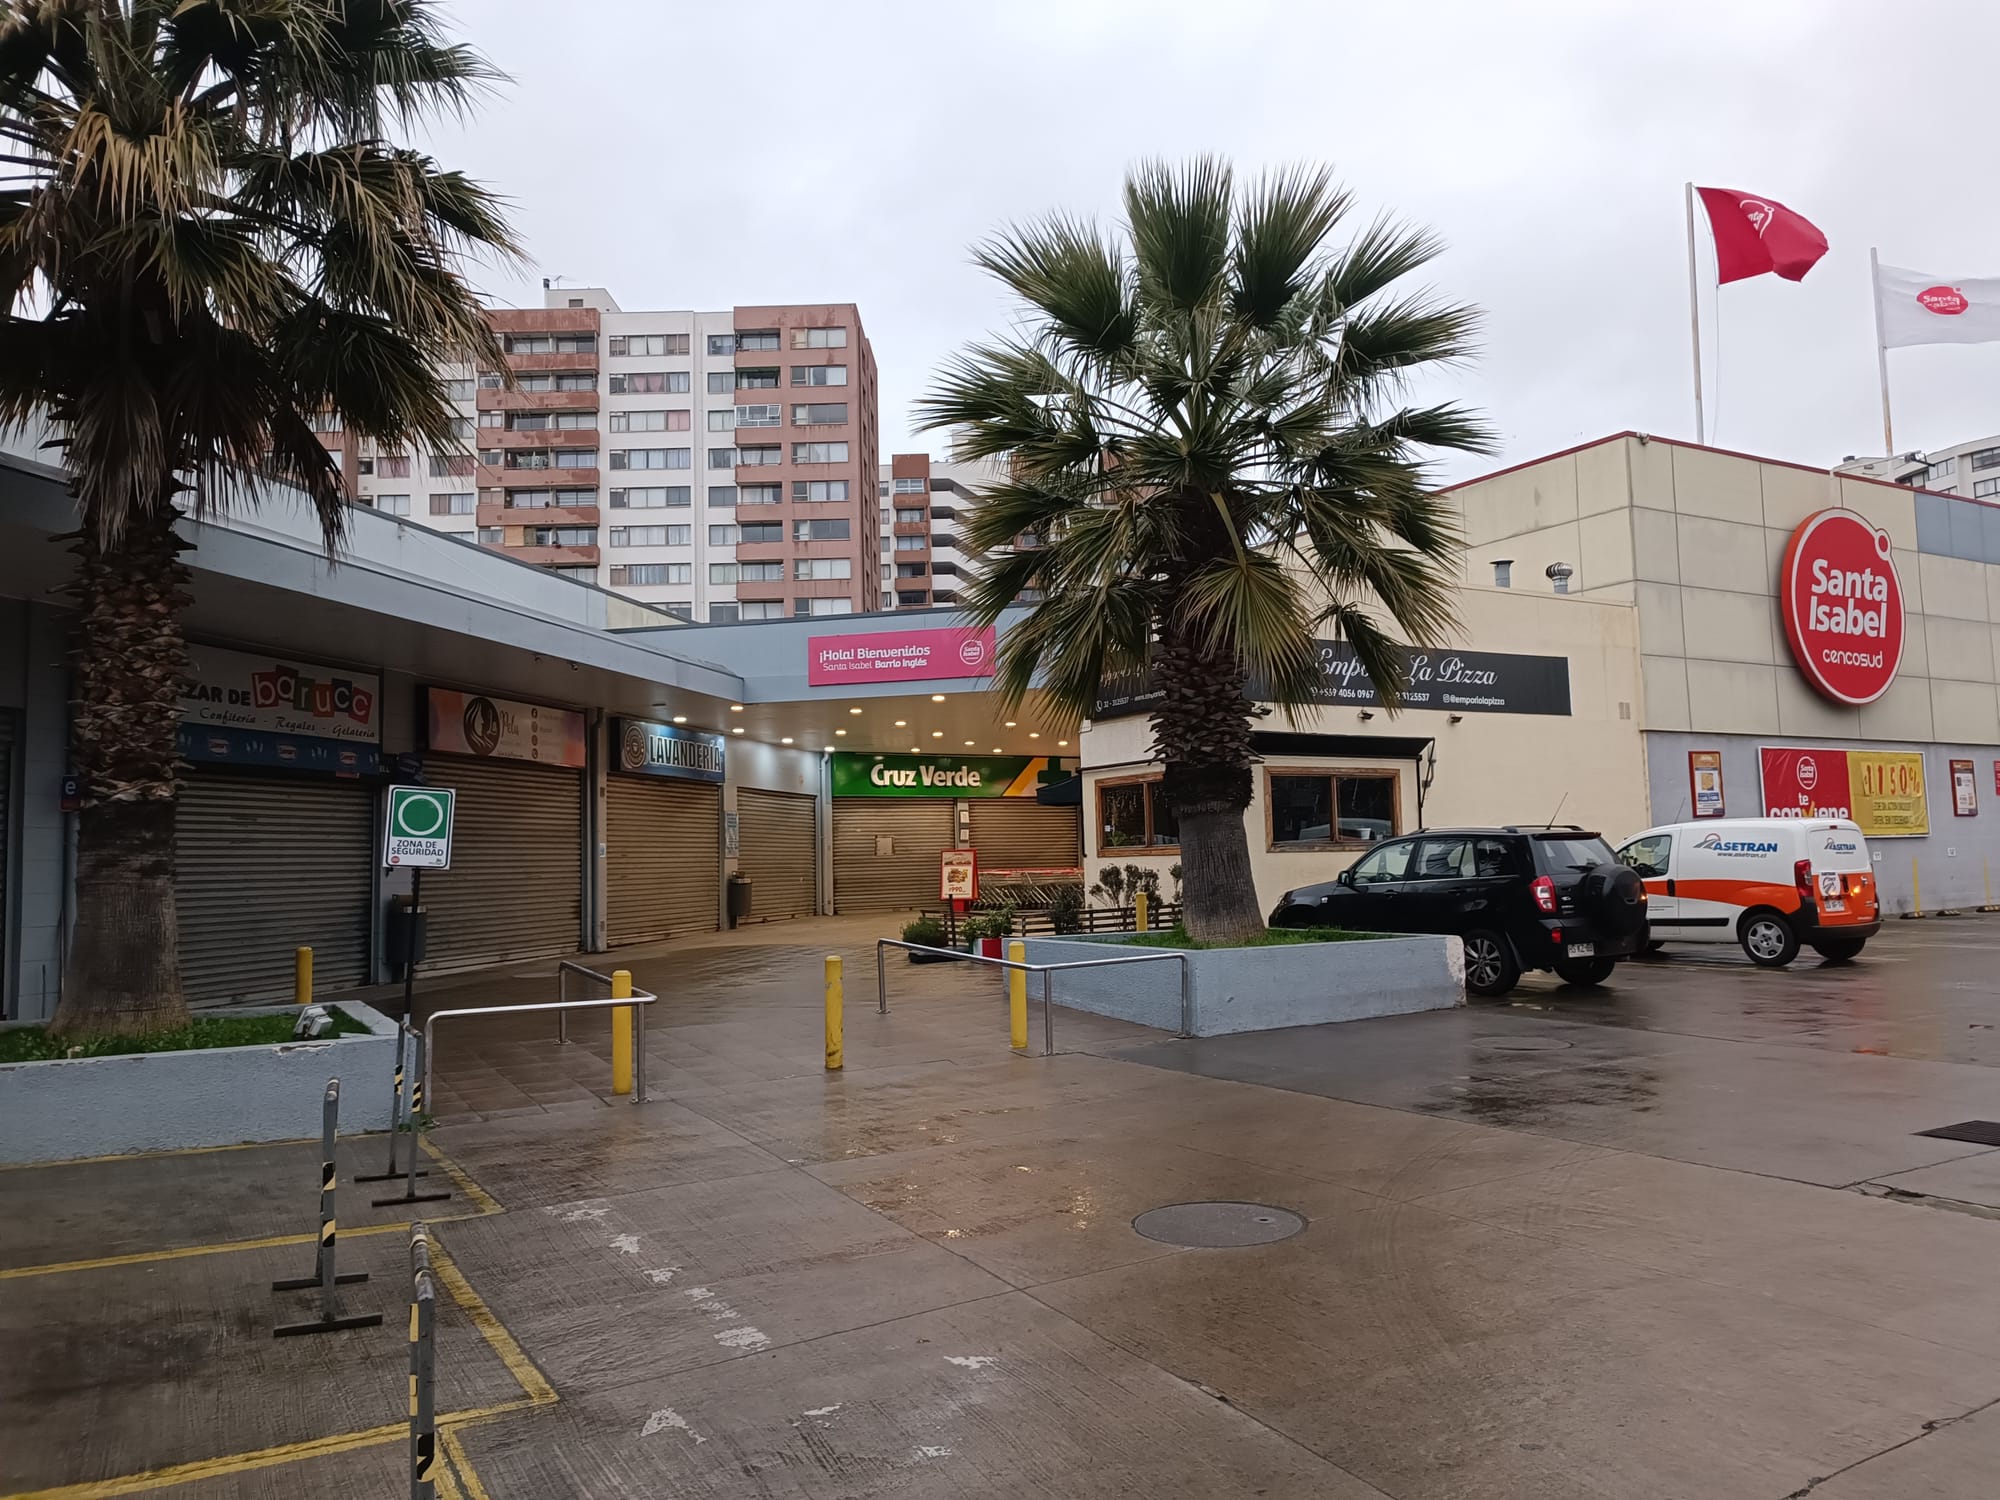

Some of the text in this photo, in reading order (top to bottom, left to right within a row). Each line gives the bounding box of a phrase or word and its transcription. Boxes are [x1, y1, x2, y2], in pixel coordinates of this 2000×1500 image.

[1811, 558, 1888, 602] Santa
[1809, 595, 1888, 638] Isabel
[819, 645, 931, 663] ¡Hola! Bienvenidos
[1822, 649, 1883, 669] cencosud
[823, 657, 927, 672] Santa Isabel Barrio Inglés
[1402, 654, 1435, 686] La
[1437, 656, 1498, 685] Pizza
[228, 688, 251, 707] DE
[1338, 688, 1356, 698] 4056
[1356, 689, 1375, 699] 0967
[649, 734, 722, 773] LAVANDERÍA
[870, 763, 981, 786] Cruz Verde
[1798, 791, 1809, 806] te
[391, 846, 444, 857] SEGURIDAD
[396, 839, 437, 849] ZONA DE
[1712, 841, 1778, 853] ASETRAN
